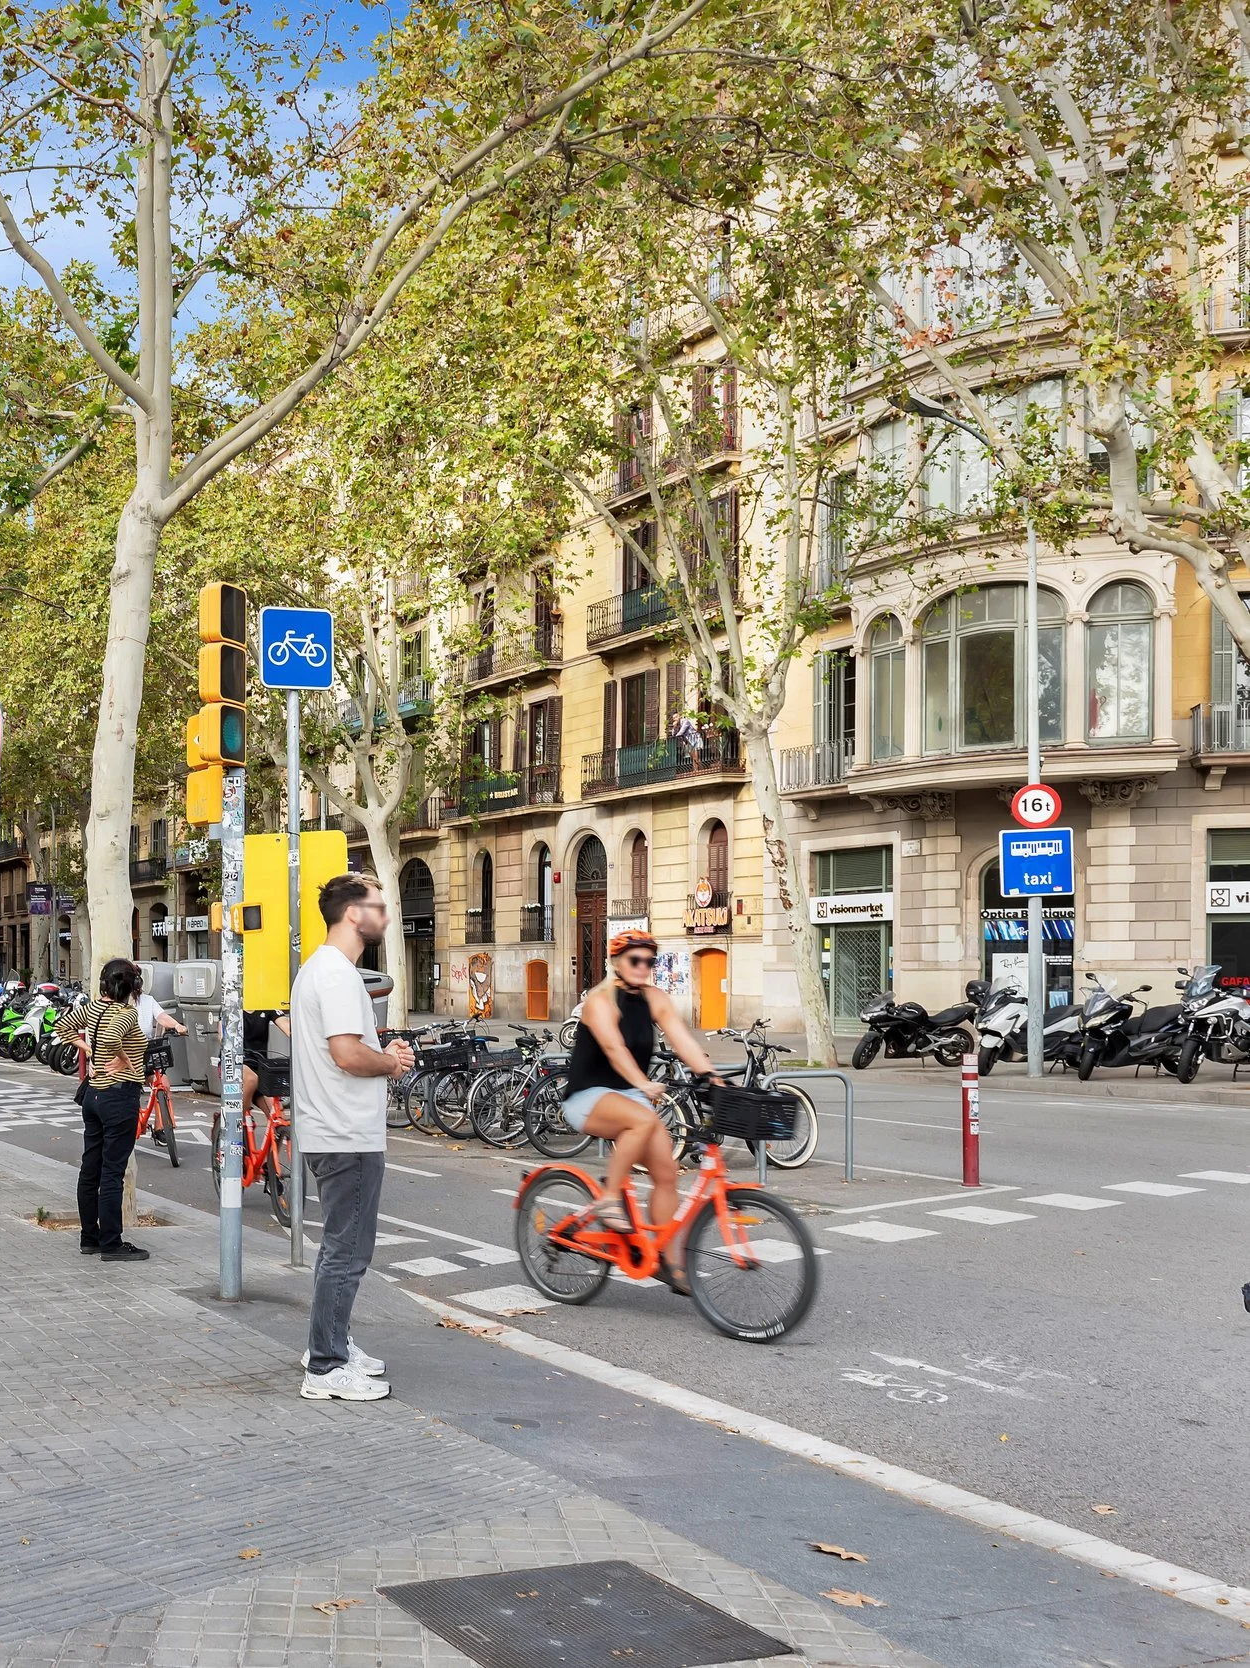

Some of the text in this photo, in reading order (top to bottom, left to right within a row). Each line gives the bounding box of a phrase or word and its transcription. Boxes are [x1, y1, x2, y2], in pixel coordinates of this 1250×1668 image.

[1024, 872, 1052, 885] taxi
[830, 903, 883, 914] visionmarket
[1021, 908, 1074, 920] Btique
[682, 906, 728, 928] AKATSUKI
